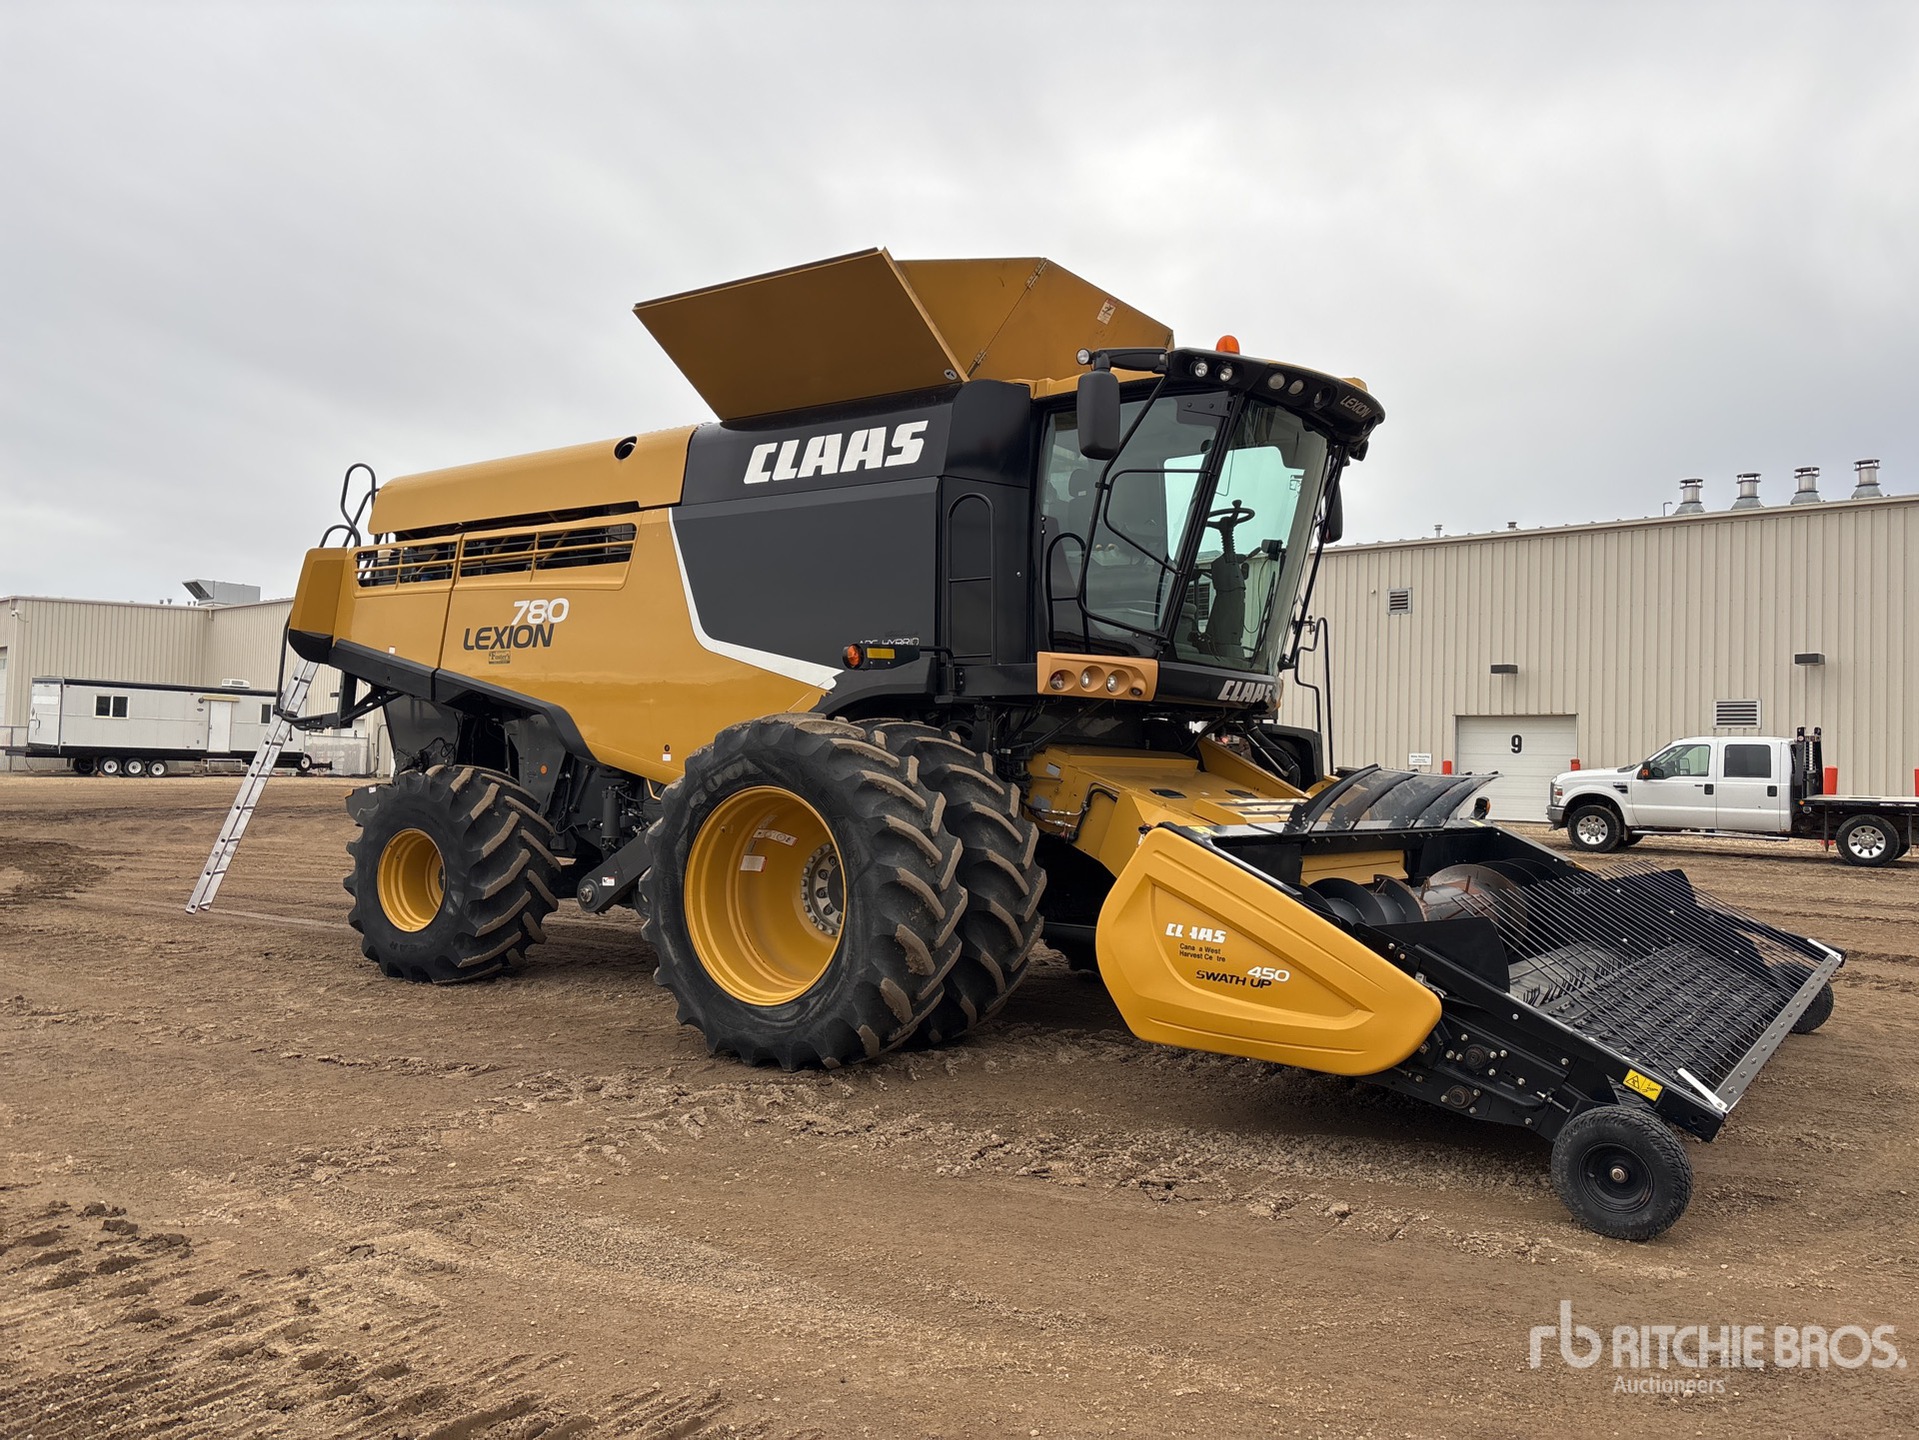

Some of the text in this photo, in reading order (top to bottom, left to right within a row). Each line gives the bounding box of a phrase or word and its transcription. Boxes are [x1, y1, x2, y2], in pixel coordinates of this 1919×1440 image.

[1340, 395, 1372, 418] LEXION
[743, 420, 929, 485] CLAAS
[511, 598, 570, 625] 780
[463, 623, 555, 650] LEXION
[1510, 734, 1523, 754] 9
[1179, 943, 1221, 955] Canaa West
[1179, 950, 1226, 962] Harvest Cetre
[1196, 970, 1272, 988] SWATH UP
[1247, 966, 1290, 982] 450
